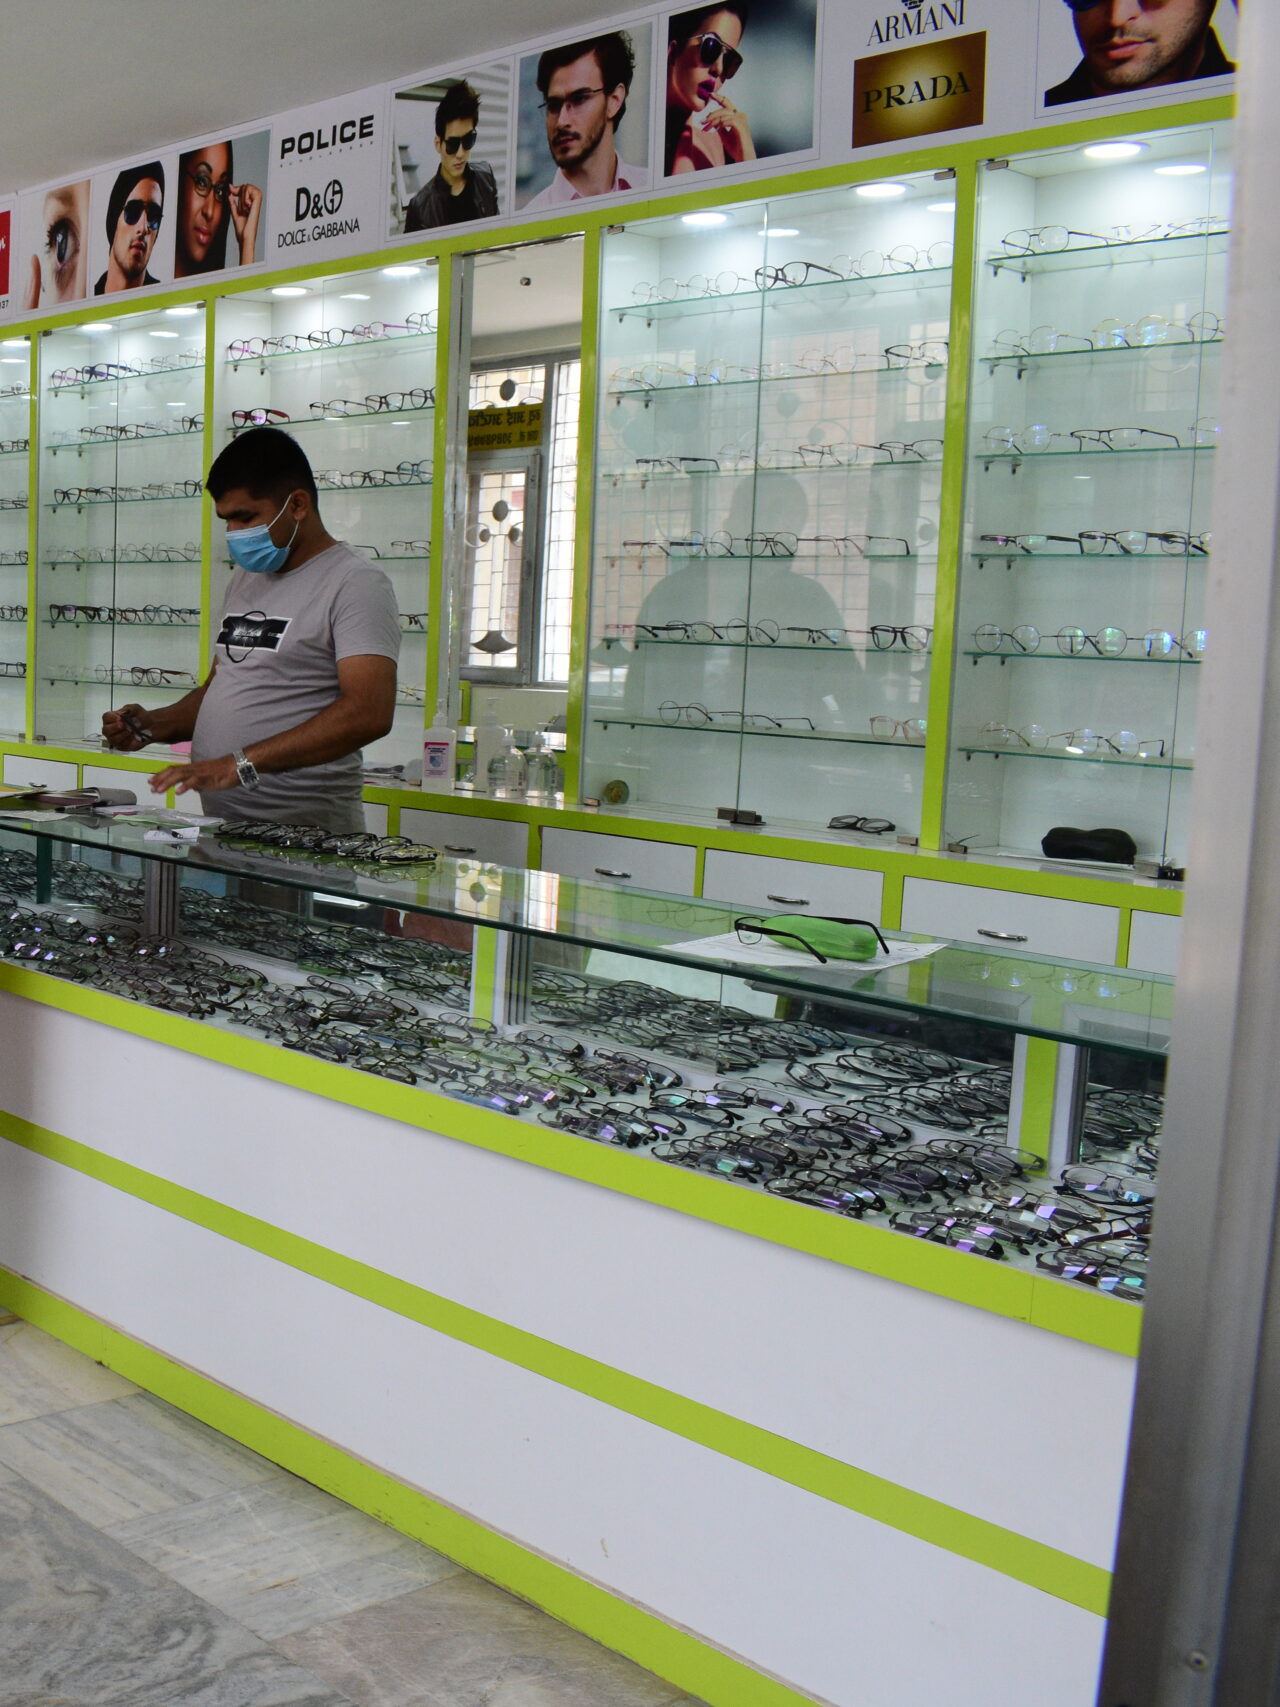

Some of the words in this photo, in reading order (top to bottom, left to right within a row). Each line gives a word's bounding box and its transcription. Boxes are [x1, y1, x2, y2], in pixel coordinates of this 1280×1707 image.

[866, 0, 966, 46] ARMANI
[863, 71, 971, 114] PRADA
[280, 114, 374, 160] POLICE
[295, 179, 344, 222] D&G
[277, 228, 306, 248] DOLCE
[312, 217, 360, 241] GABBANA
